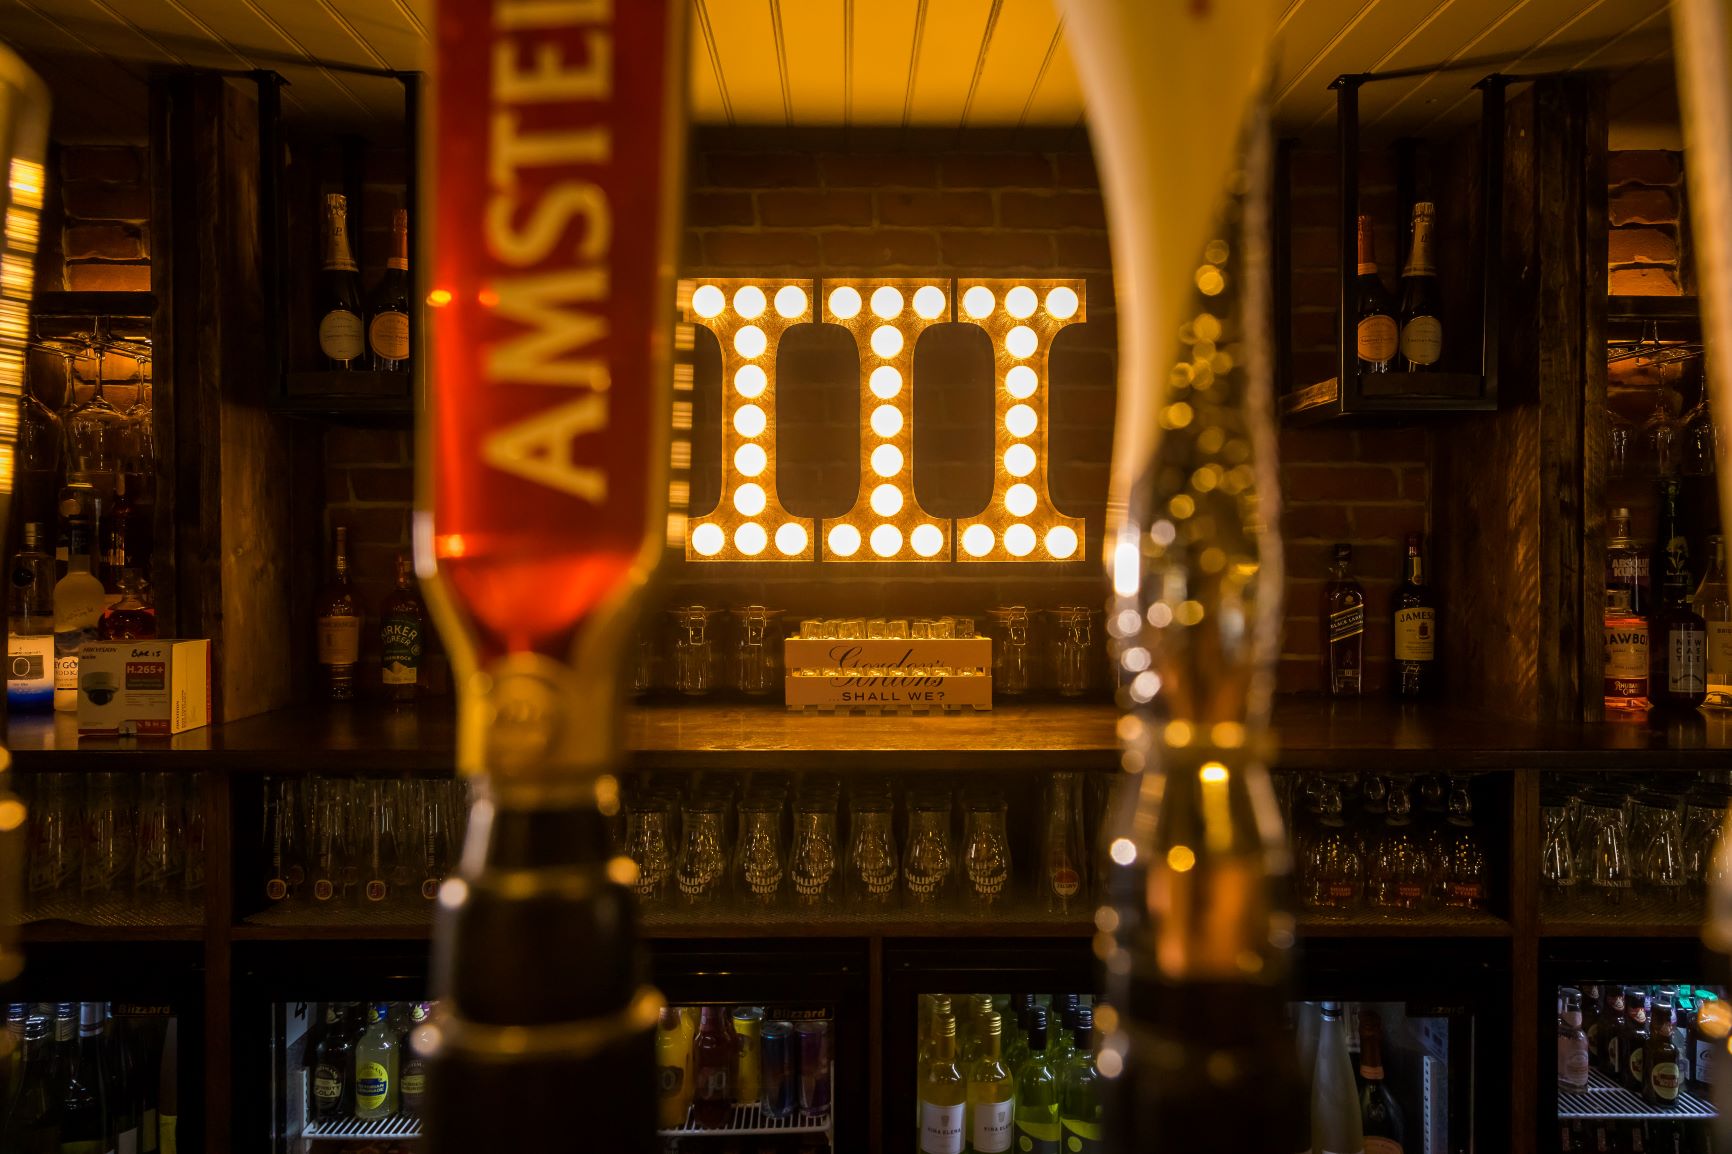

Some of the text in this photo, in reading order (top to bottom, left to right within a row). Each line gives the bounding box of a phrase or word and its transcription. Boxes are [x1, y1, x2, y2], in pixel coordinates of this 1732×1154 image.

[127, 665, 163, 674] H.265+
[908, 691, 945, 701] WE?
[772, 1007, 826, 1019] Blizzard
